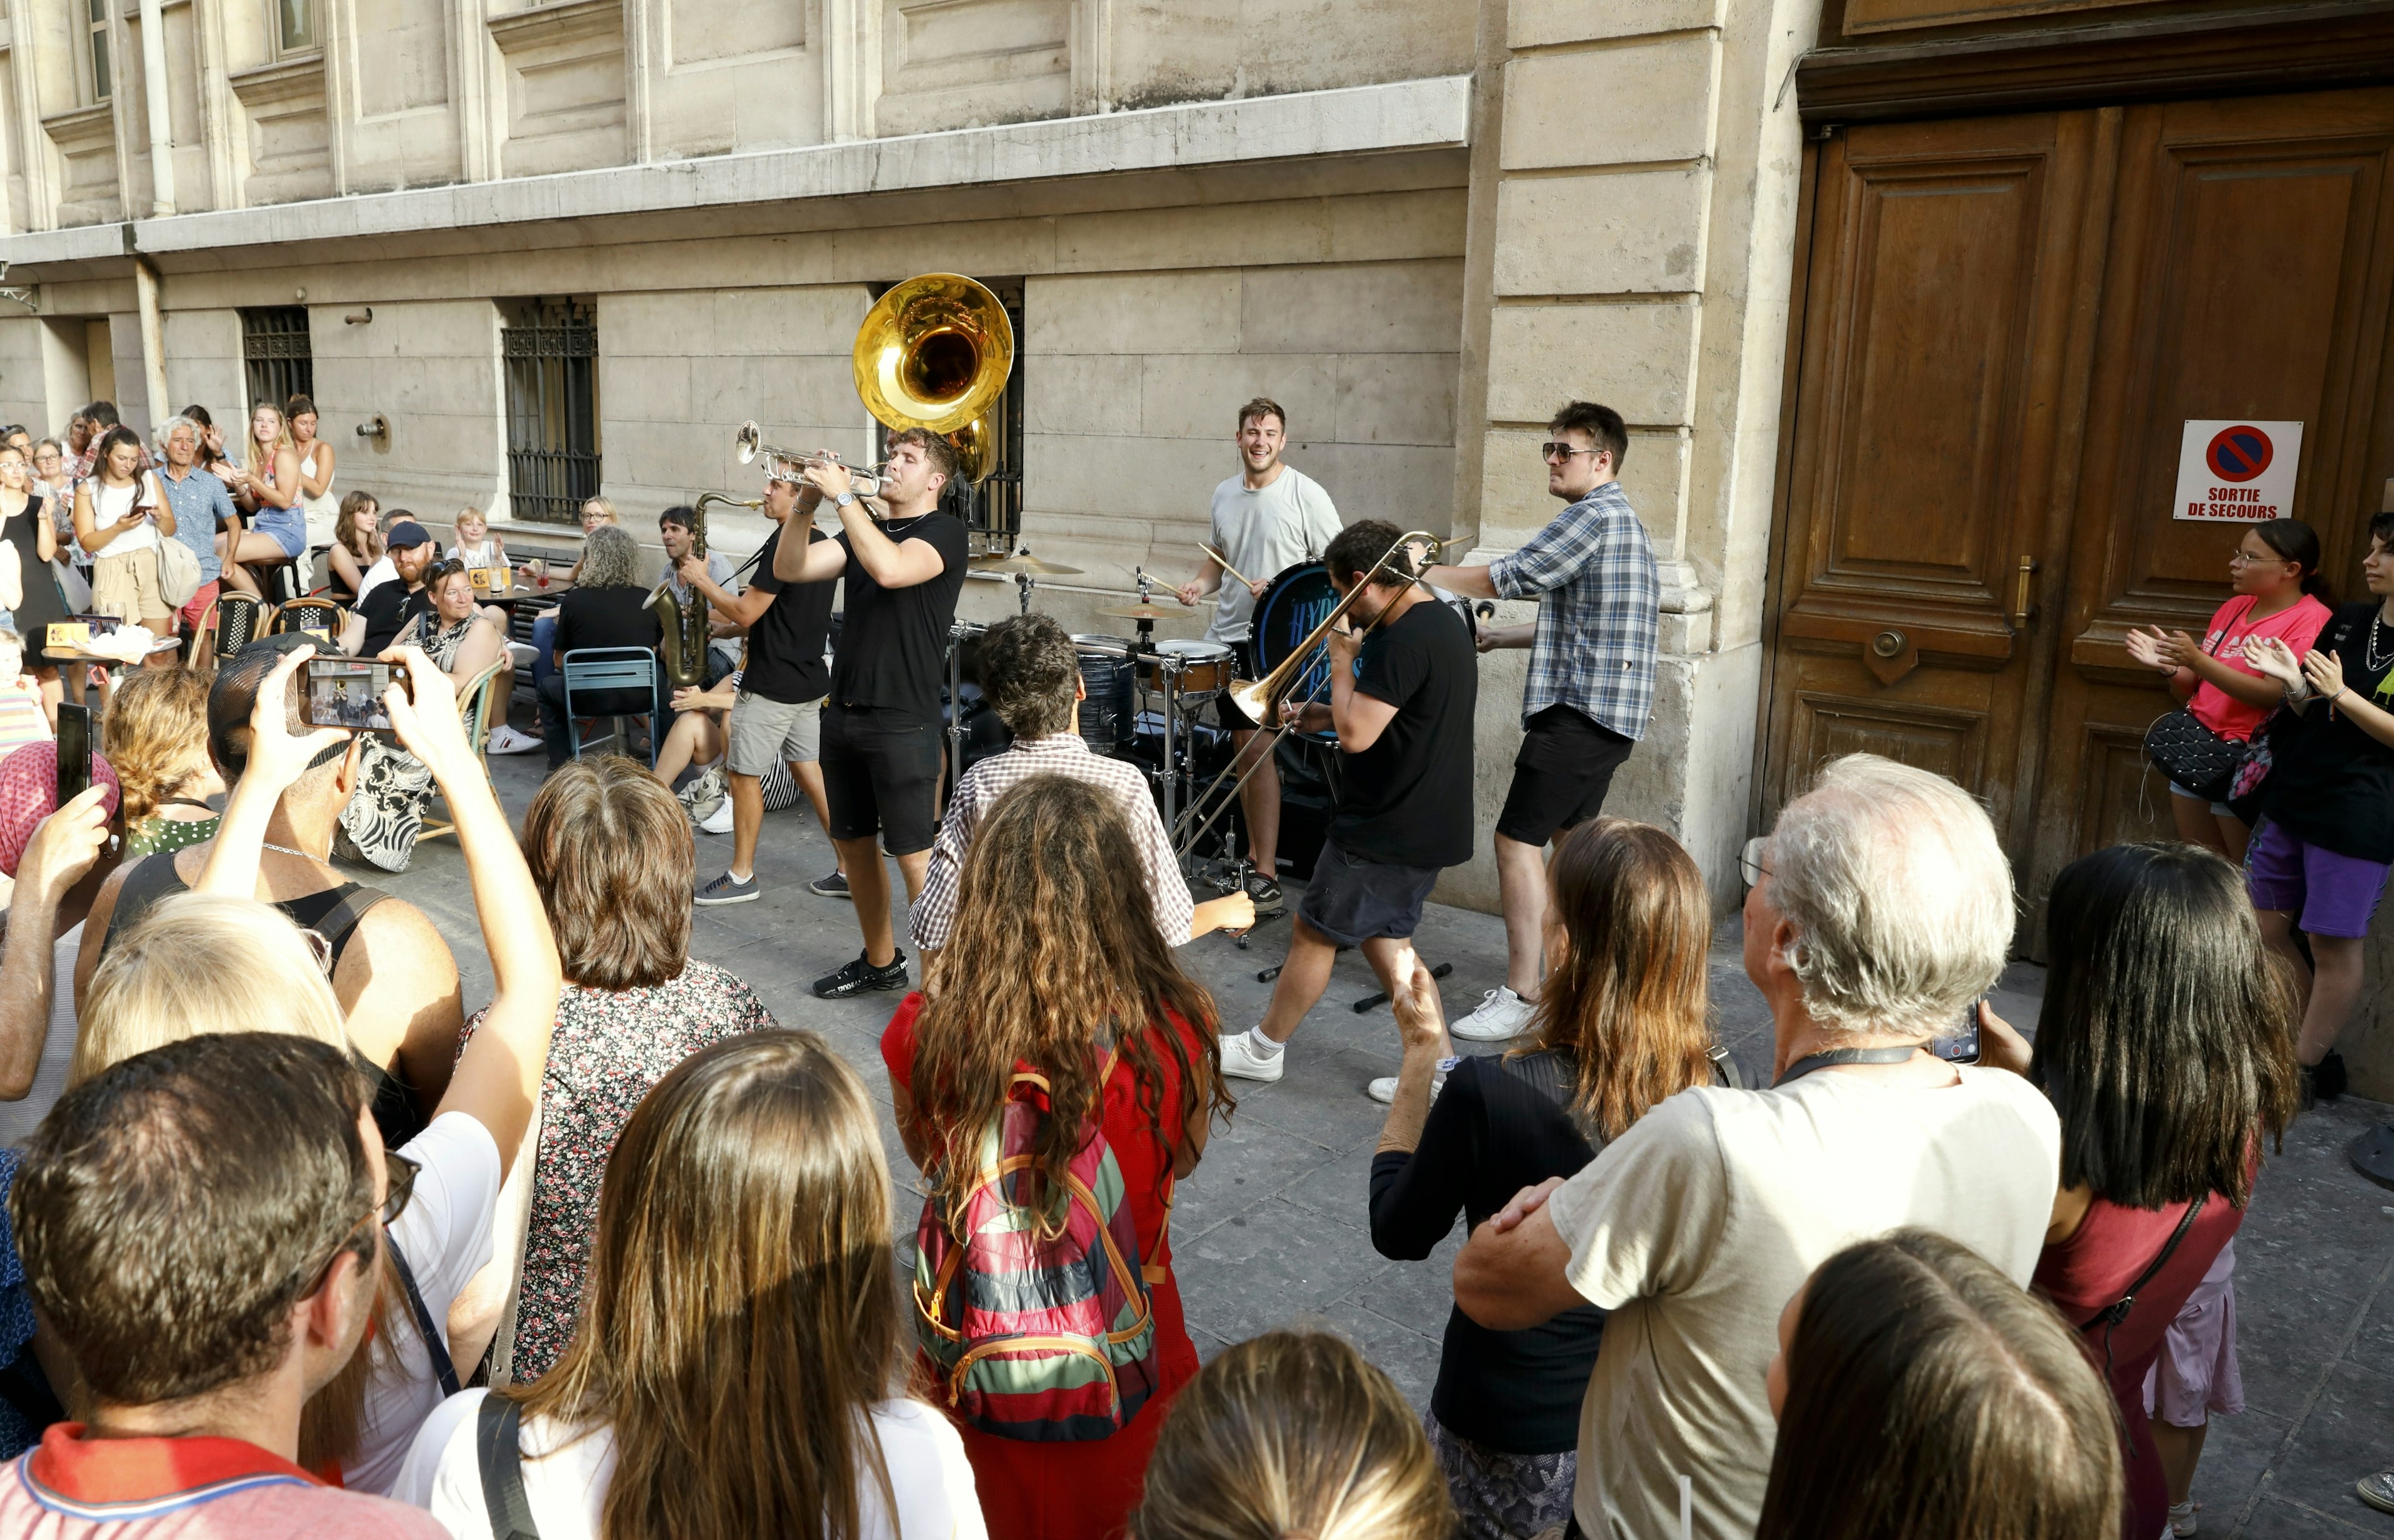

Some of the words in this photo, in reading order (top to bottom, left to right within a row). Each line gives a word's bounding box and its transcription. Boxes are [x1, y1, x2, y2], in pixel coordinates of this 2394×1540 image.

[2208, 488, 2261, 502] SORTIE
[2188, 503, 2206, 516] DE
[2209, 504, 2277, 519] SECOURS
